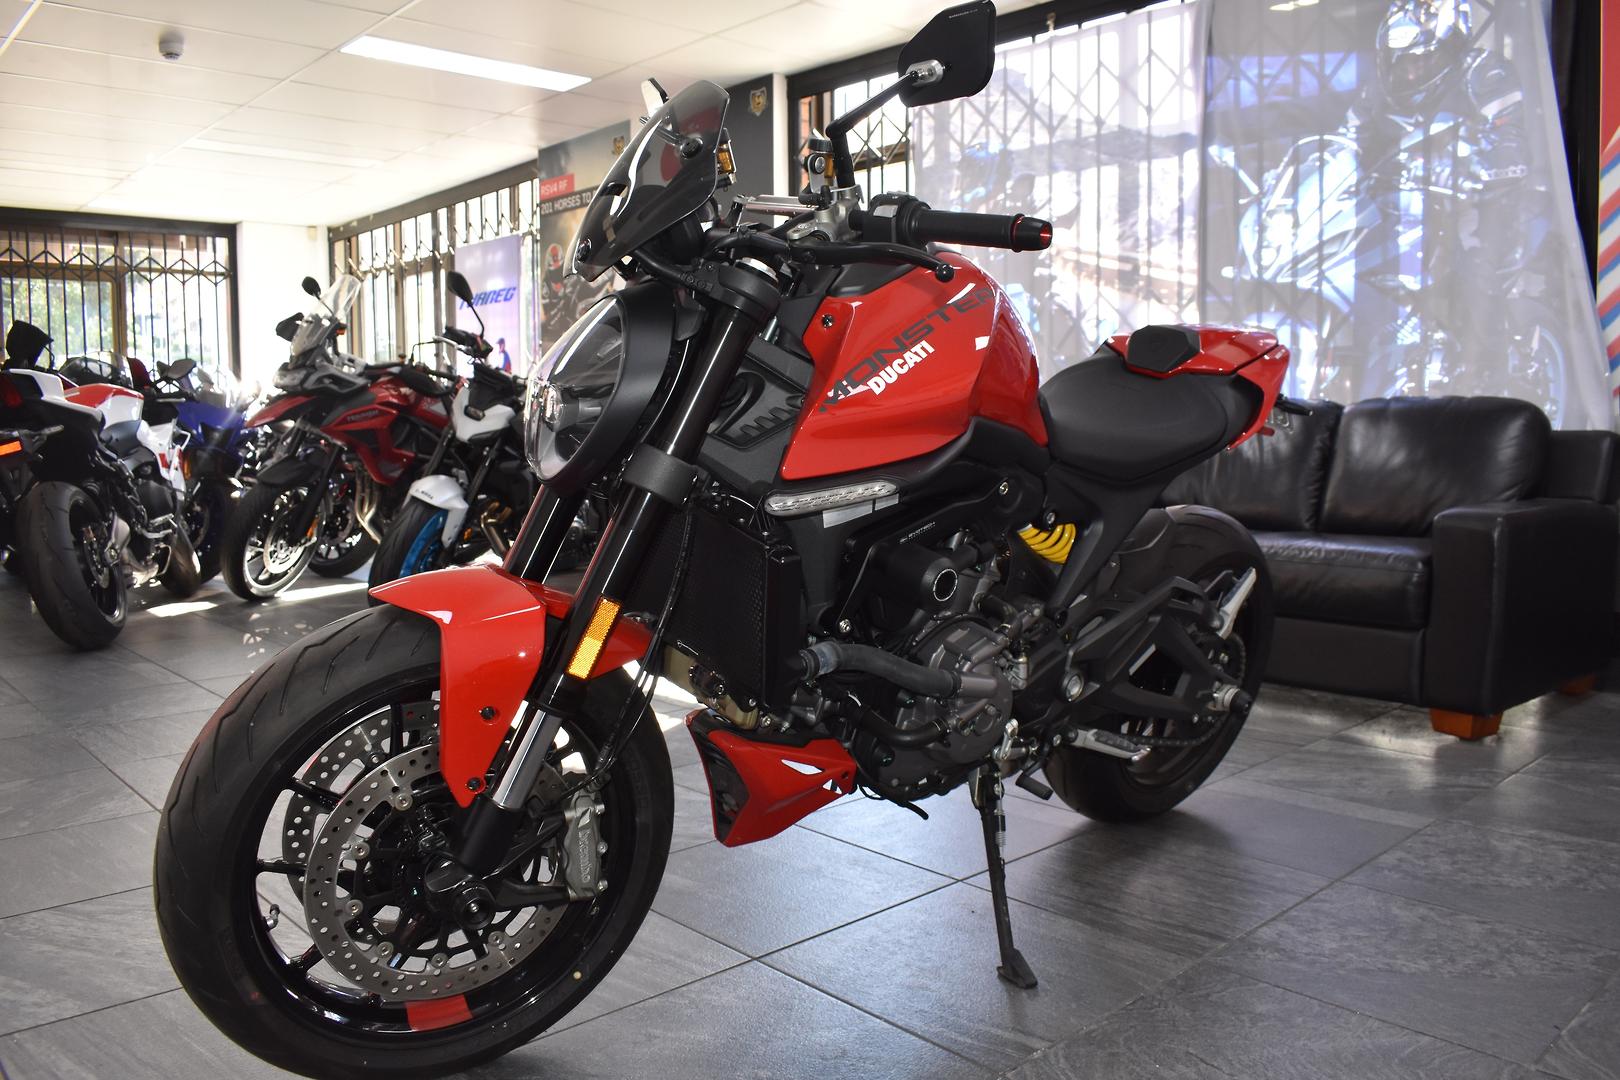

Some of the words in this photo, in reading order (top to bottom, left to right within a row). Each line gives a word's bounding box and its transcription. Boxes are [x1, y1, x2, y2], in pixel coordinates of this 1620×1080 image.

[540, 202, 553, 215] 201
[554, 194, 580, 211] HORSES
[582, 191, 592, 204] TO
[818, 286, 993, 413] MONSTER
[866, 340, 936, 396] DUCATI
